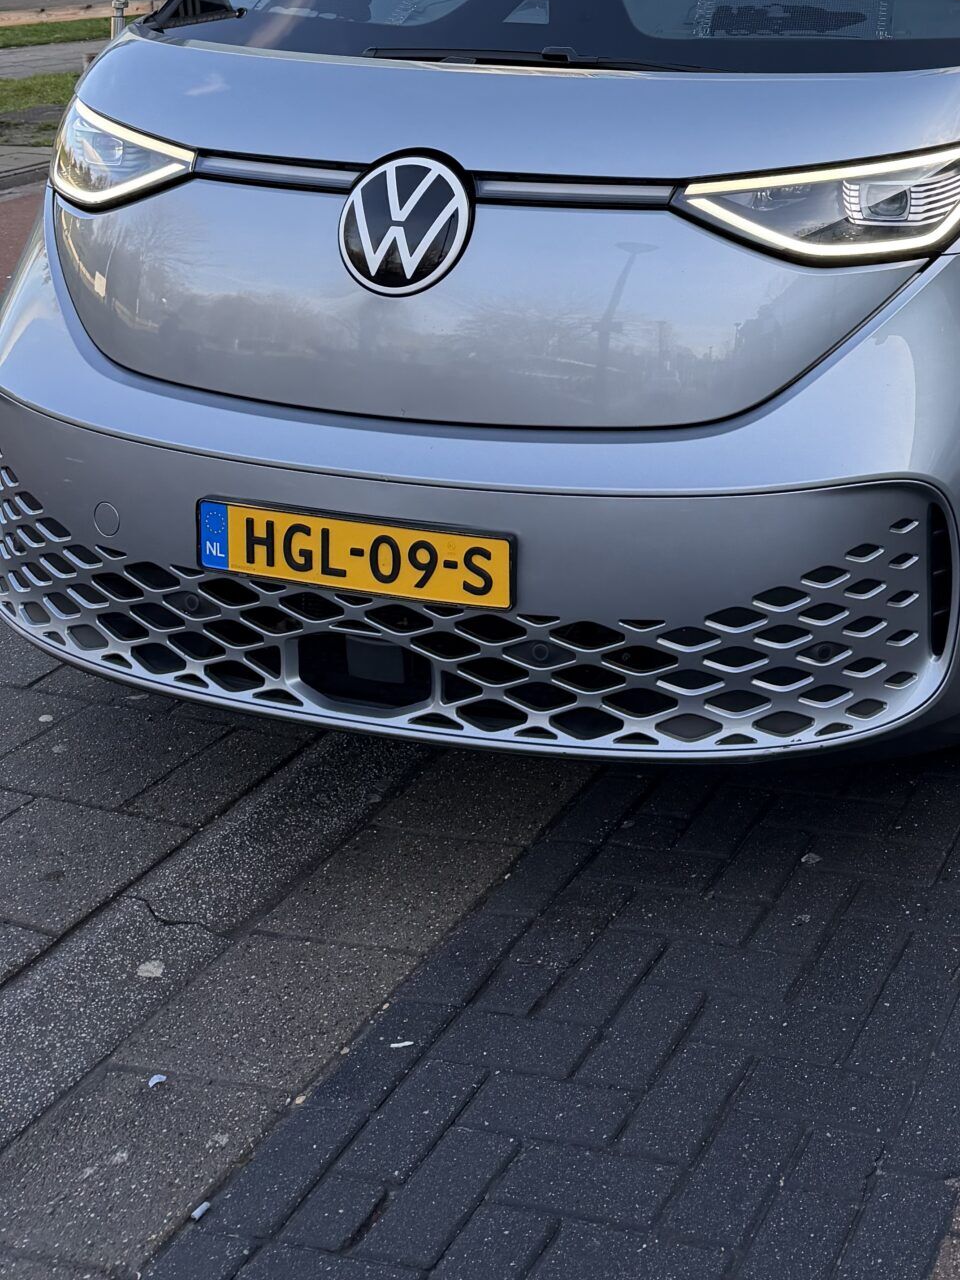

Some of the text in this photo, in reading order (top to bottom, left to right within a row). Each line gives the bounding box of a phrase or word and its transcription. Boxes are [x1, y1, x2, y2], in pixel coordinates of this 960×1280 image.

[350, 163, 462, 280] VW
[205, 517, 493, 596] NL HGL-09-S
